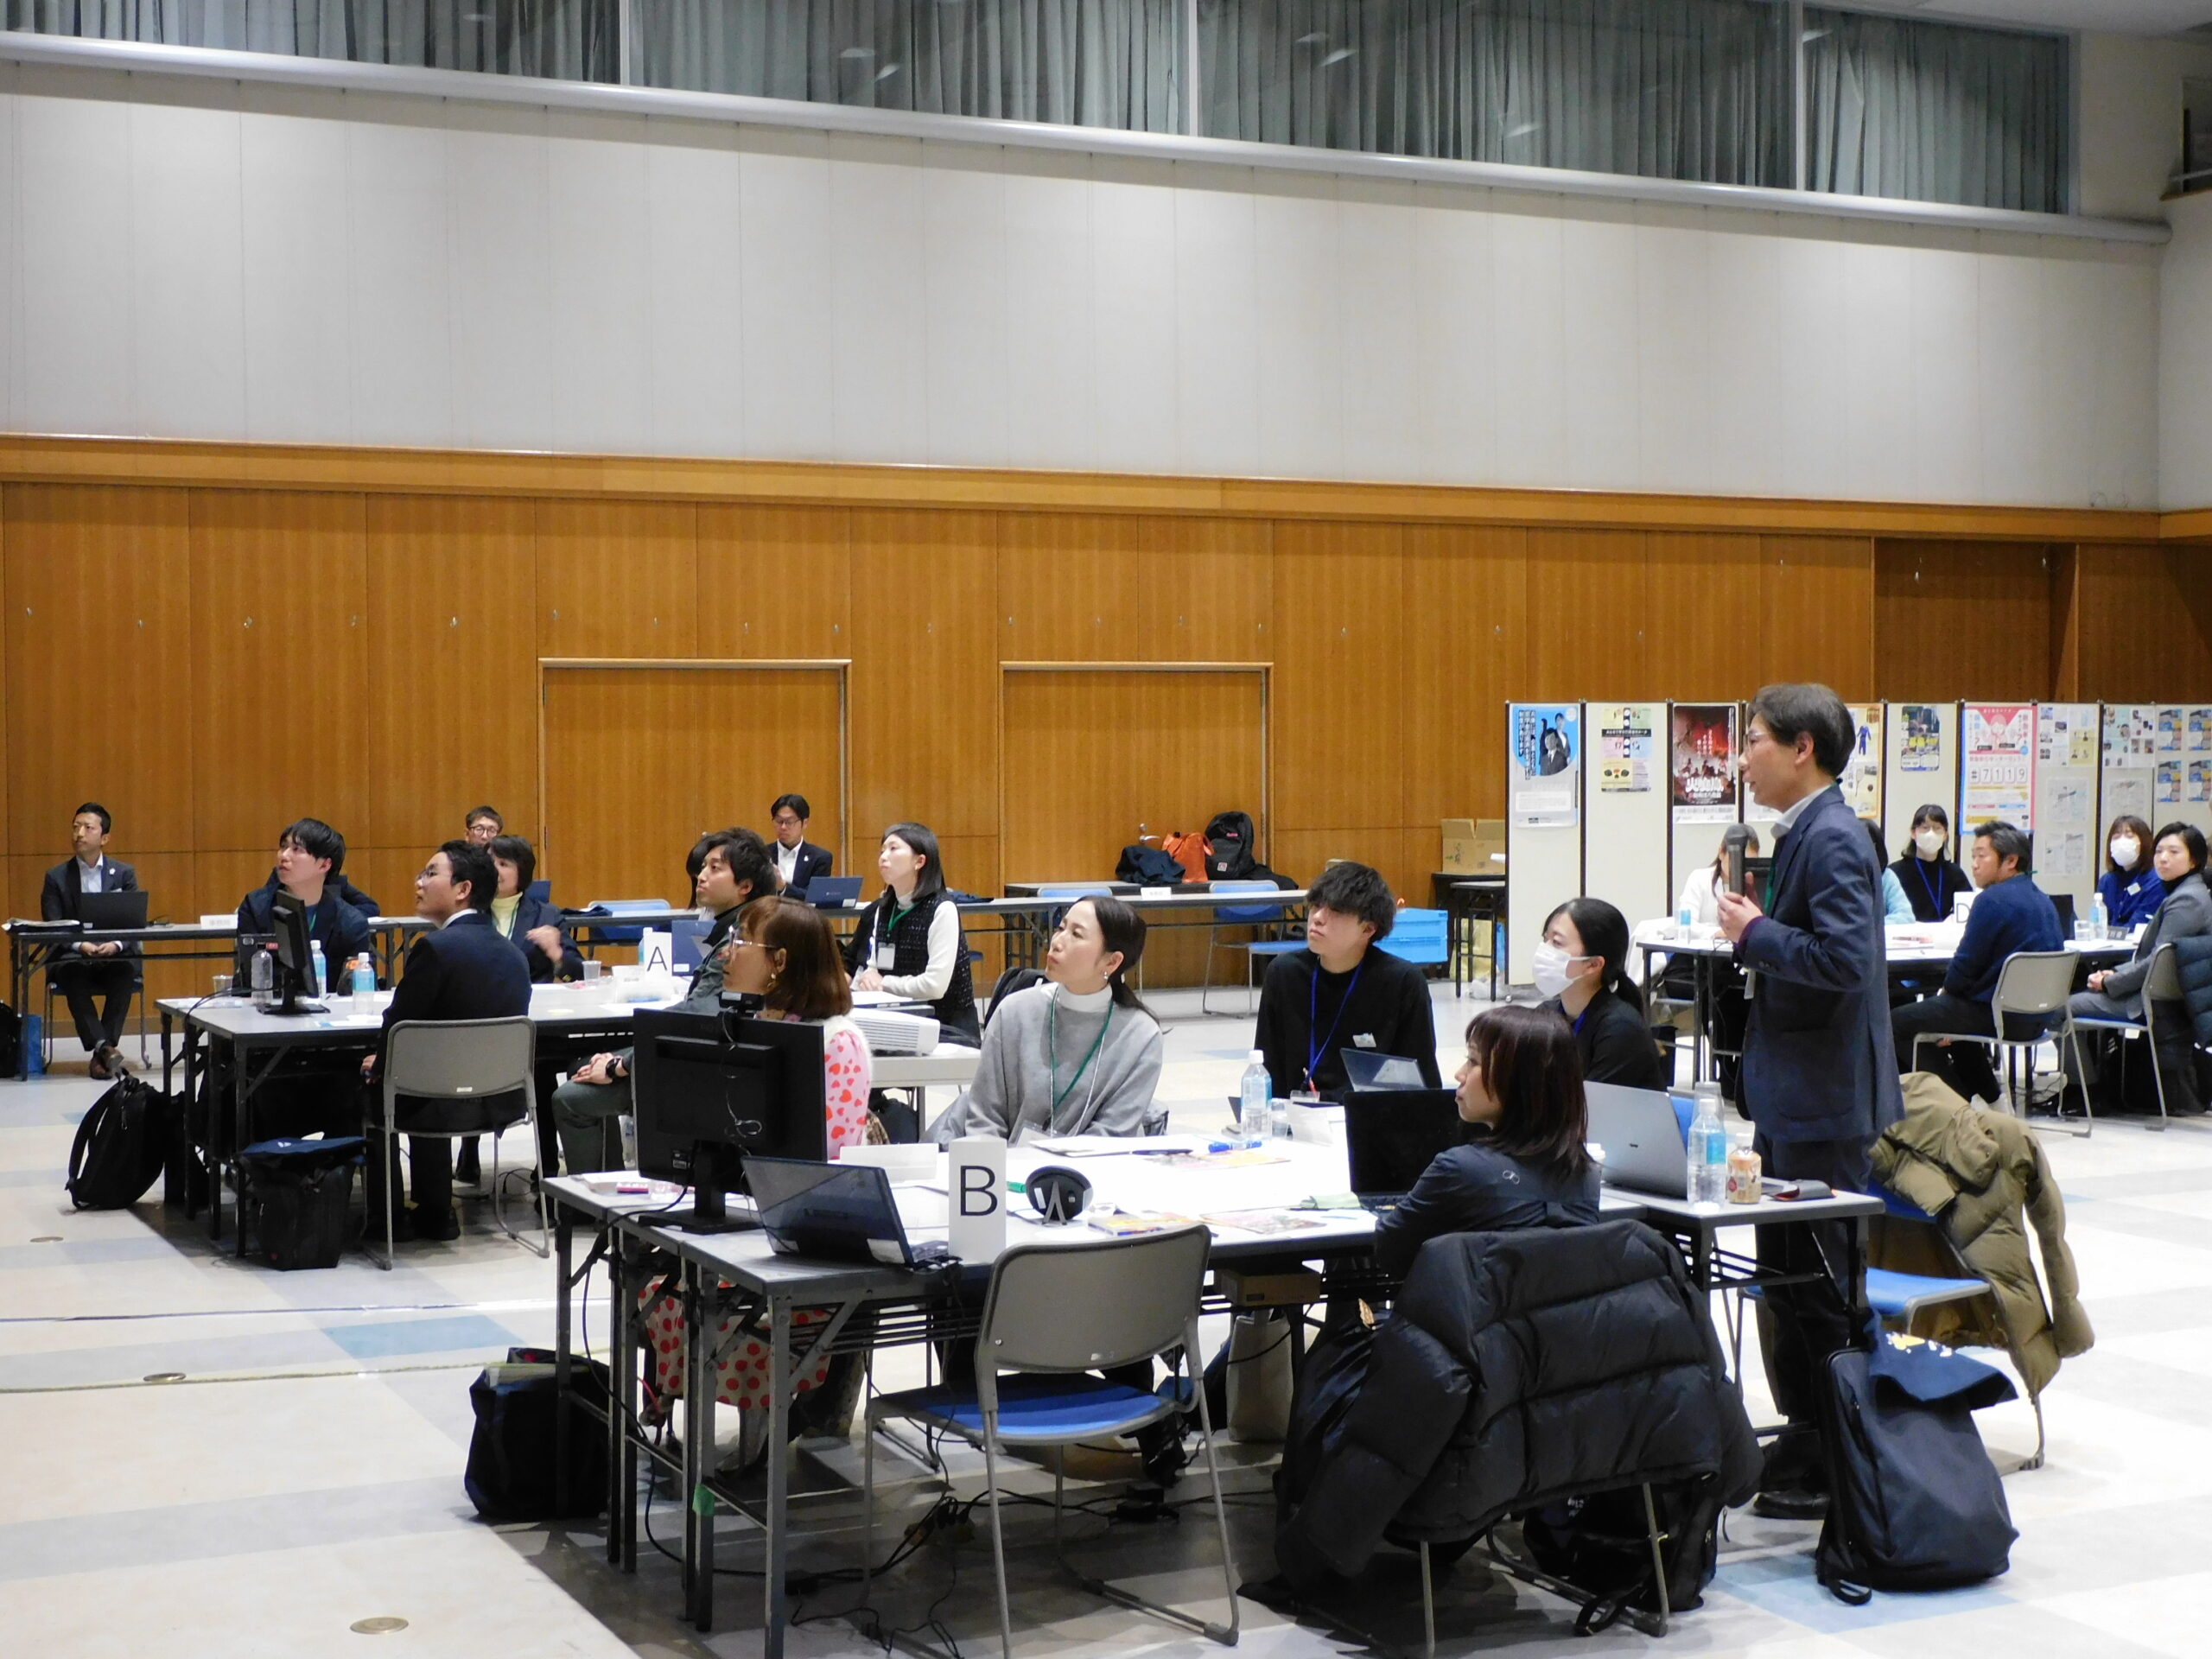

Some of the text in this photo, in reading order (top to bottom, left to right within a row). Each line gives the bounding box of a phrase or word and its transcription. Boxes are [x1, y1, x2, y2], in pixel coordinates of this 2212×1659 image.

[1971, 768, 2026, 779] #7119
[1956, 903, 1971, 923] D
[647, 946, 668, 972] A
[960, 1165, 998, 1217] B
